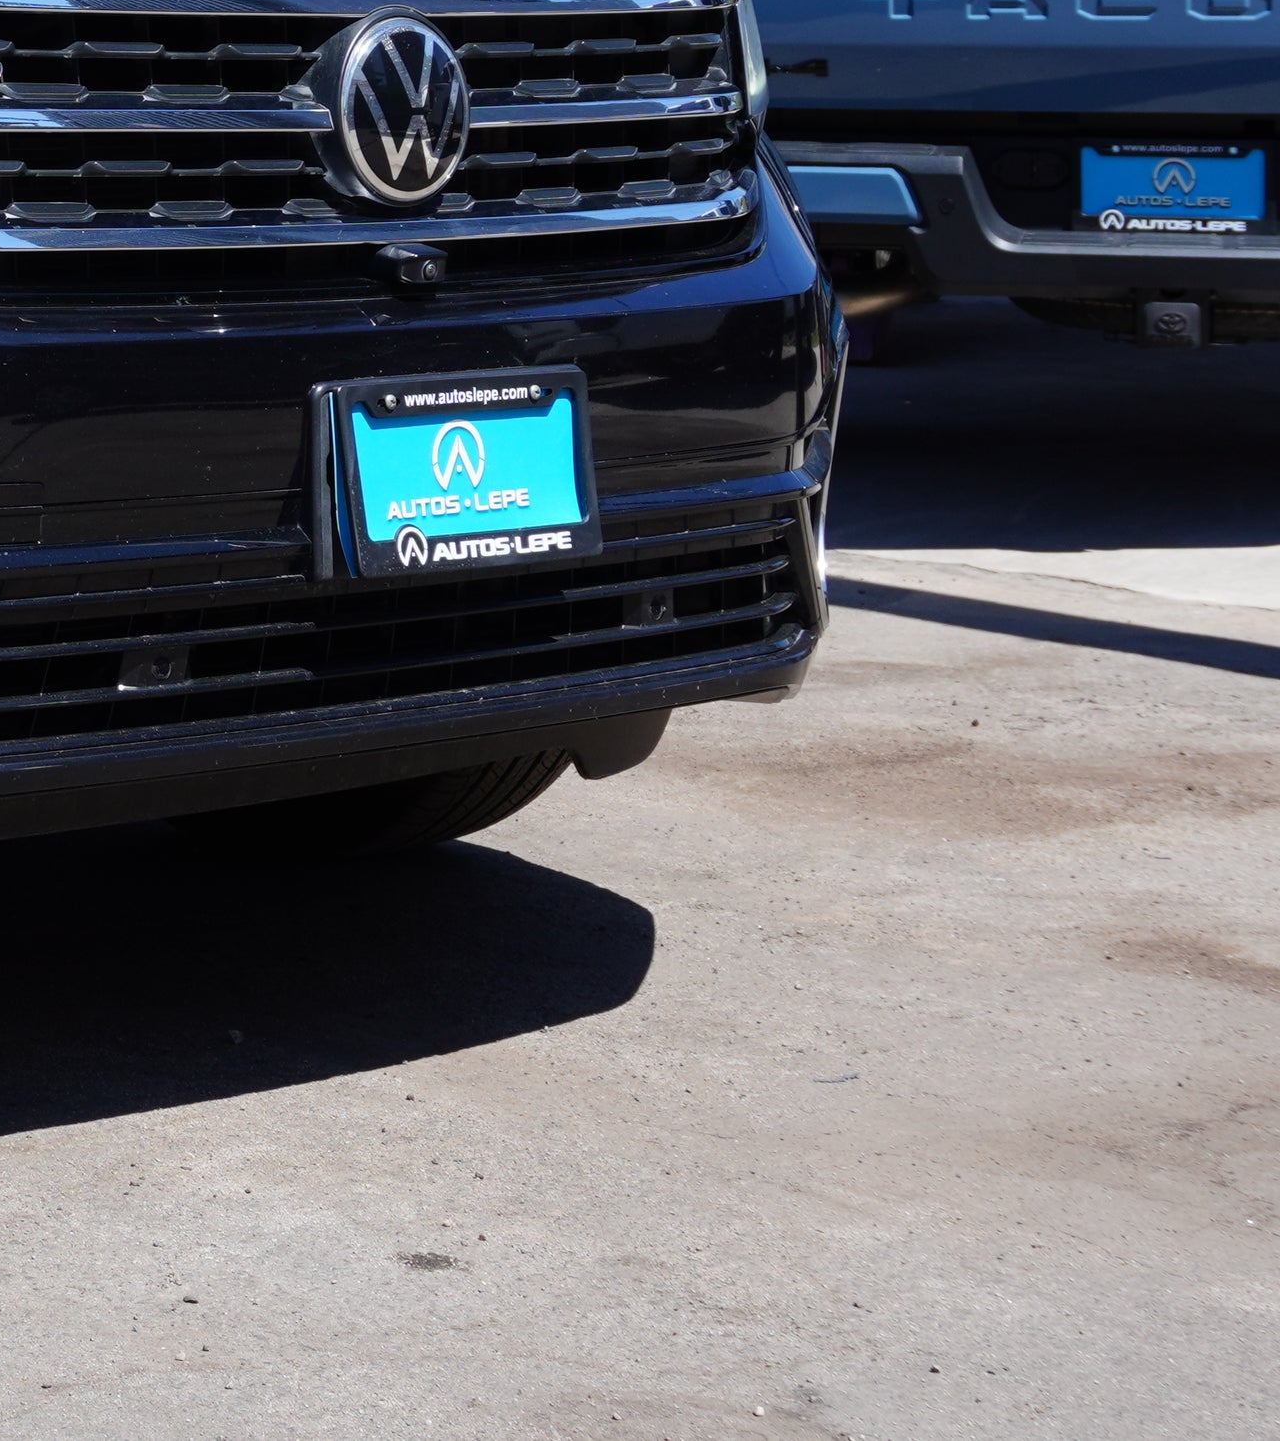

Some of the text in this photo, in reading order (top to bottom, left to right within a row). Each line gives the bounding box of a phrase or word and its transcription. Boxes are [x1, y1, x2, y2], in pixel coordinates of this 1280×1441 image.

[404, 386, 528, 408] www.autoslepe.com
[387, 488, 530, 521] AUTOS LEPE
